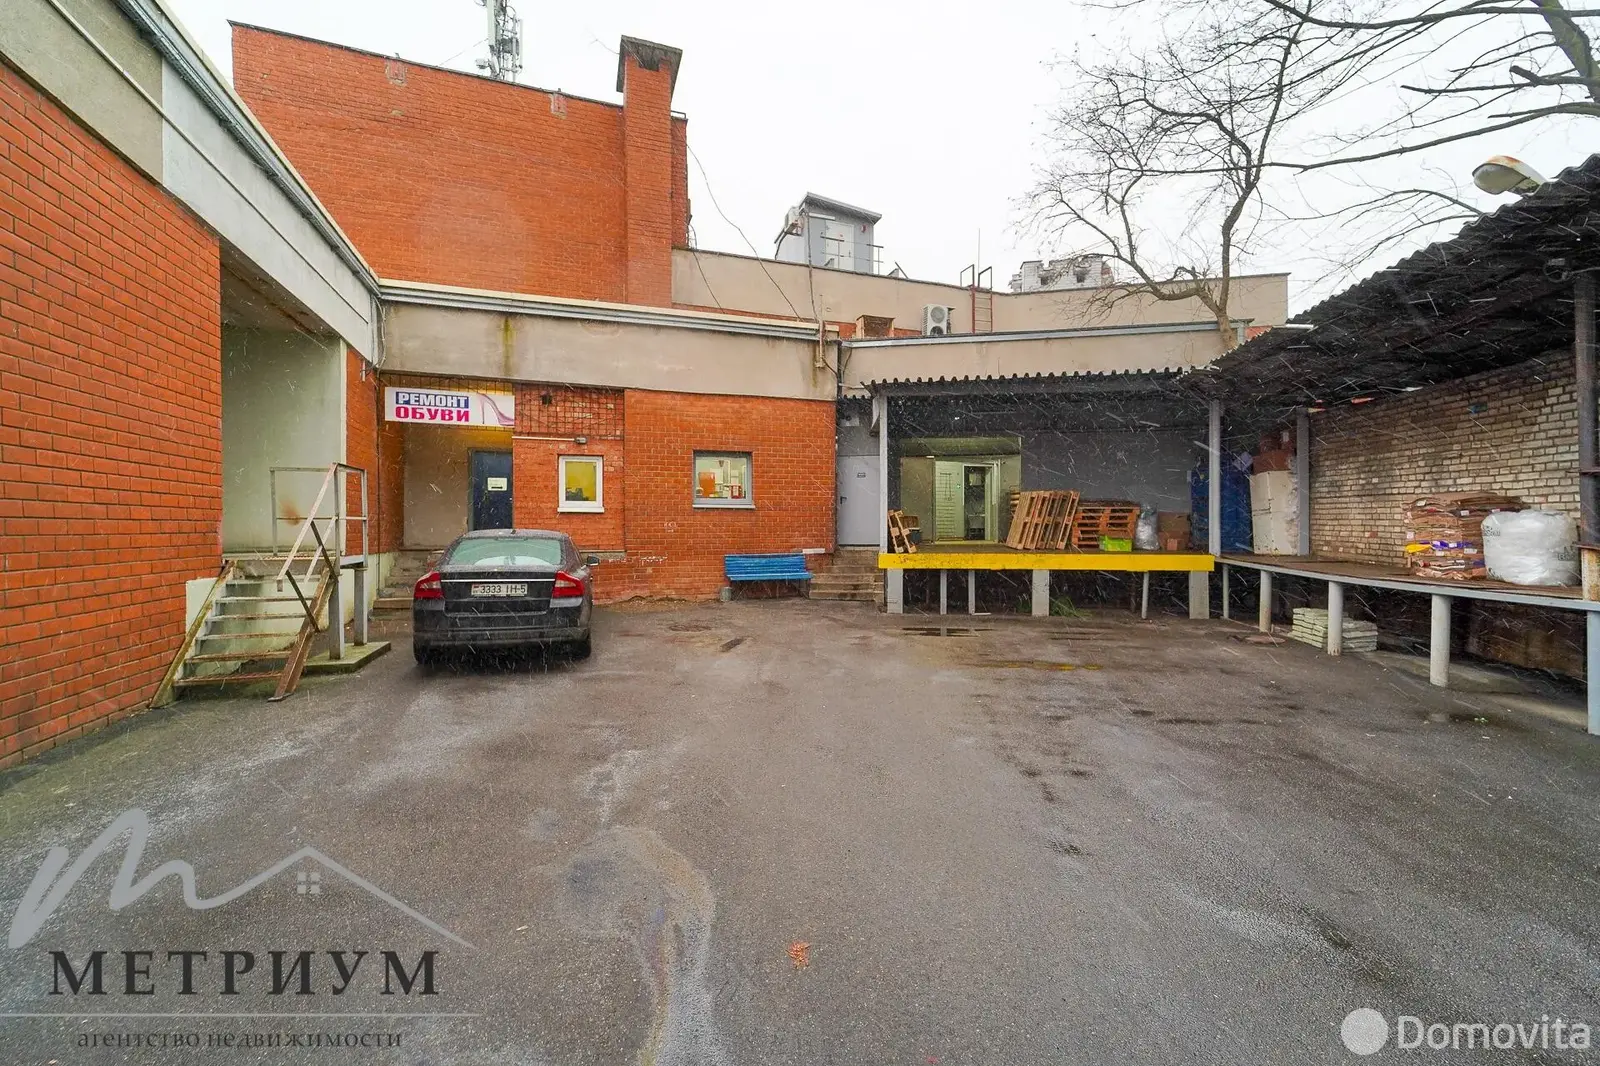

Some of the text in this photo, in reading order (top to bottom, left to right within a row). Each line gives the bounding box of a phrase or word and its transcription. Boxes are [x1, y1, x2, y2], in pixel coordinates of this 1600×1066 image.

[398, 392, 468, 408] РЕМОНТ
[395, 406, 470, 422] ОБУВИ
[480, 584, 502, 594] 3333
